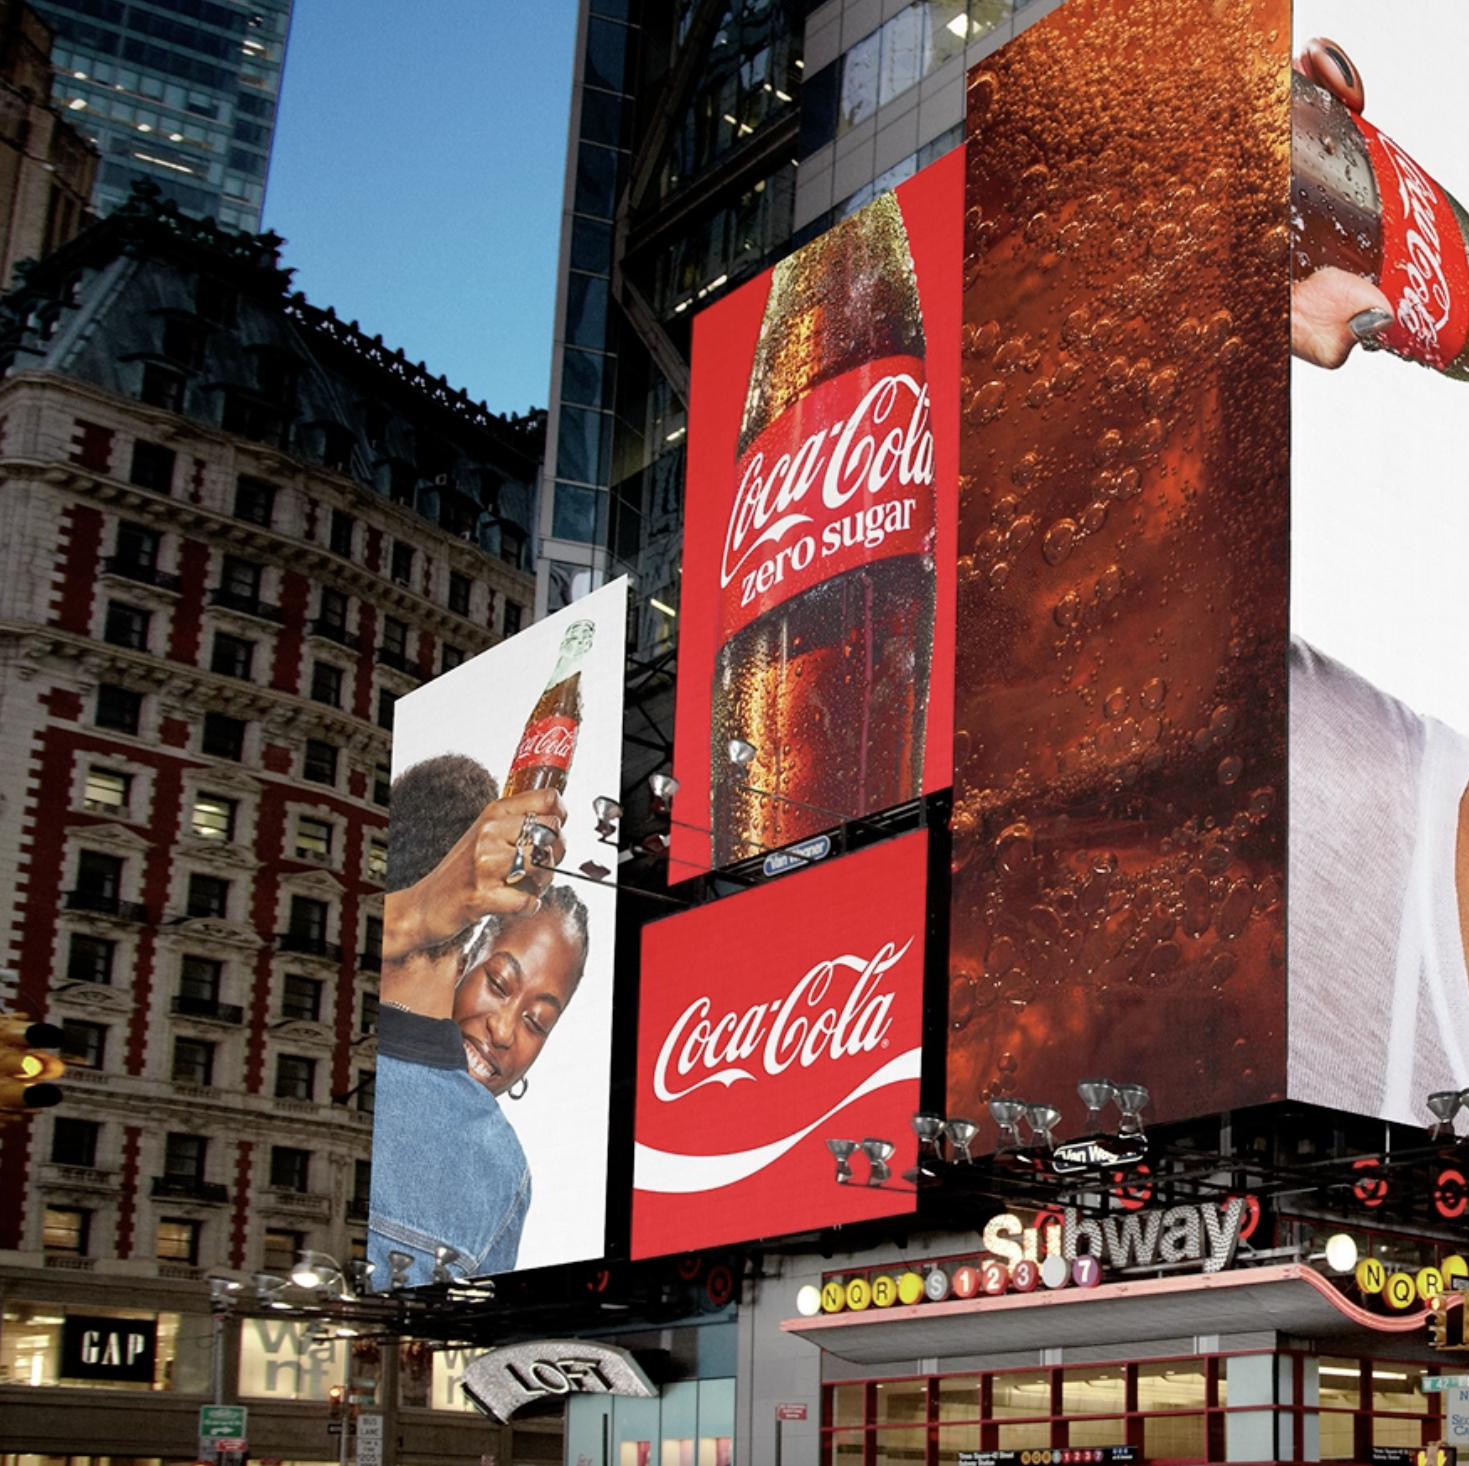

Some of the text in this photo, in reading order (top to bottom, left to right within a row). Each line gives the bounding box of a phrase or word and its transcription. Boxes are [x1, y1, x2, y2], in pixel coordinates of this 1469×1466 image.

[740, 498, 916, 608] zero sugar
[653, 935, 915, 1102] Coca-Cola
[983, 1198, 1244, 1277] Subway
[81, 1330, 145, 1366] GAP
[505, 1357, 614, 1395] LOFT
[360, 1428, 379, 1437] LANE
[363, 1417, 377, 1427] BUS
